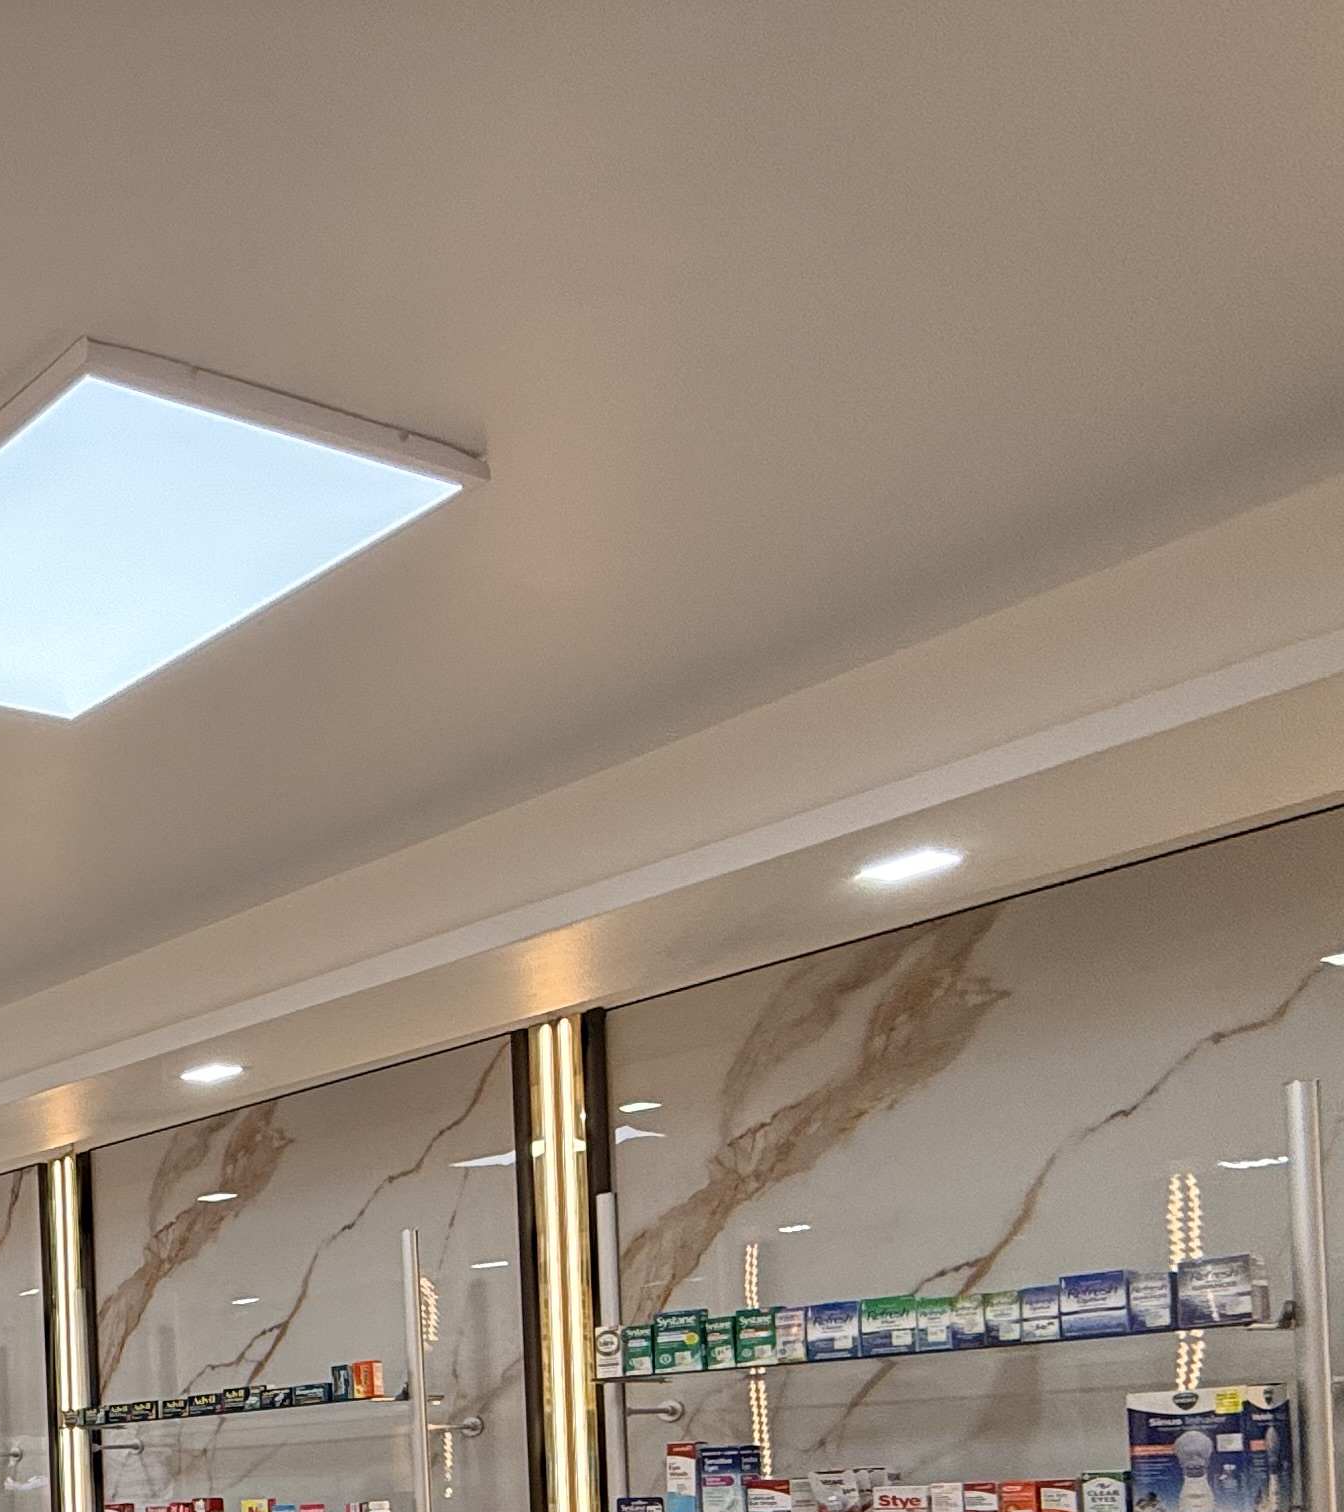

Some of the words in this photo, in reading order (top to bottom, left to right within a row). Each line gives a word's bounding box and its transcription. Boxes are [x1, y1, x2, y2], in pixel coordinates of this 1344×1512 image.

[1067, 1286, 1120, 1300] Refresh
[656, 1313, 697, 1328] Systane
[814, 1314, 852, 1326] Refresh
[867, 1309, 912, 1320] Refresh
[1149, 1417, 1182, 1427] Sinus
[878, 1495, 920, 1508] Stye
